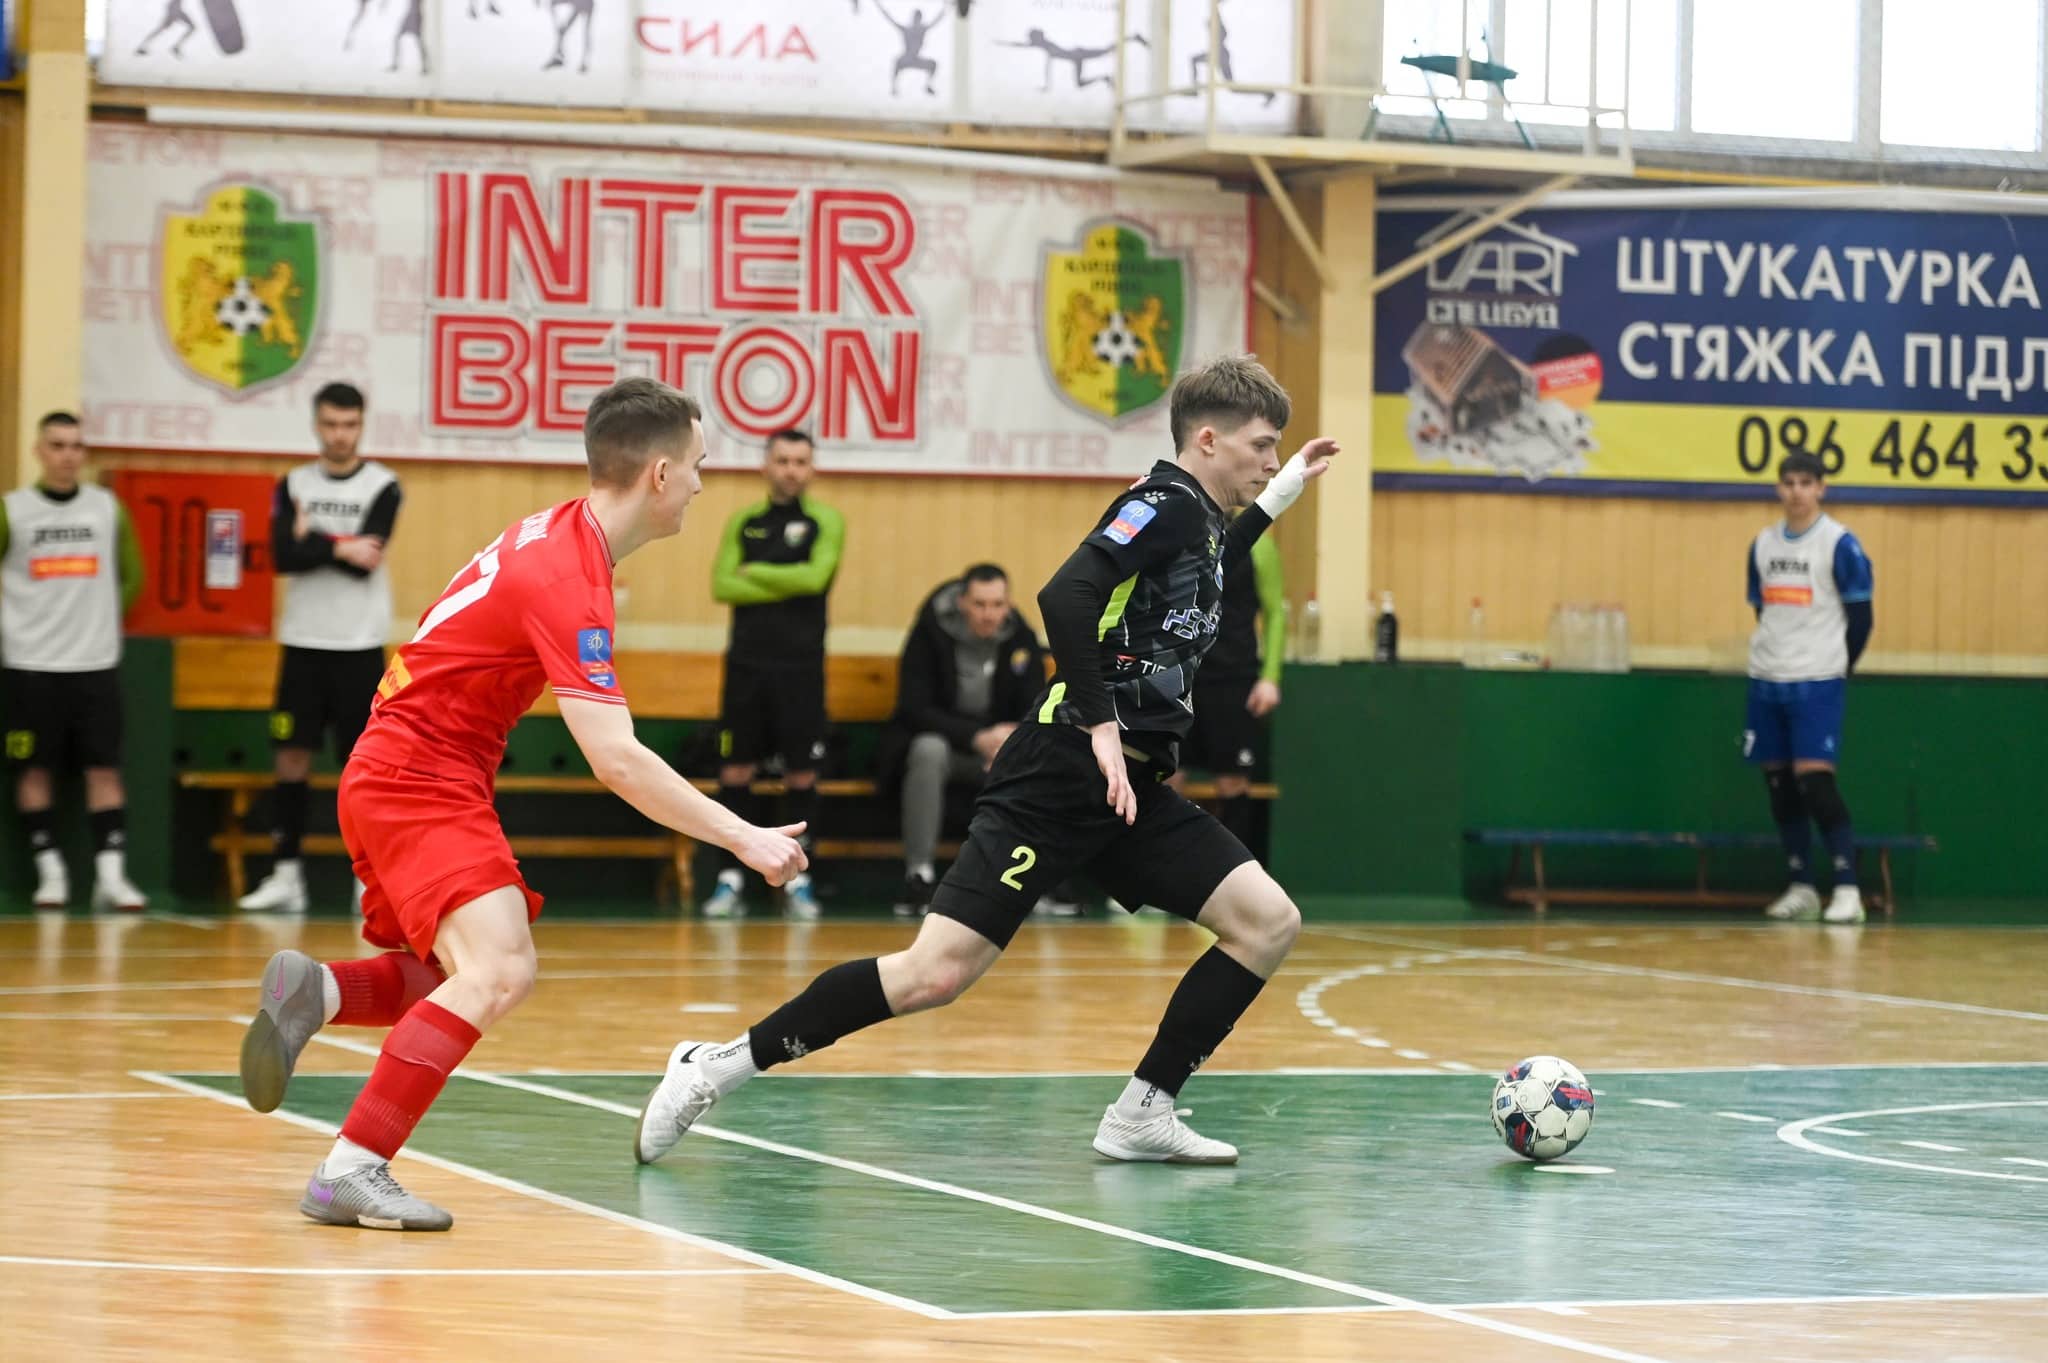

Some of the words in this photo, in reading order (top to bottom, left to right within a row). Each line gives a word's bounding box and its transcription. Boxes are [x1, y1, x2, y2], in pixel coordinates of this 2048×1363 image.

[635, 16, 818, 61] СИЛА
[434, 172, 917, 317] INTER
[1617, 236, 2042, 309] ШТУКАТУРКА
[432, 315, 919, 441] BETON
[1618, 321, 1885, 387] СТЯЖКА
[1904, 332, 2048, 402] ПІДЛ
[1871, 420, 1979, 479] 464
[1000, 845, 1036, 891] 2
